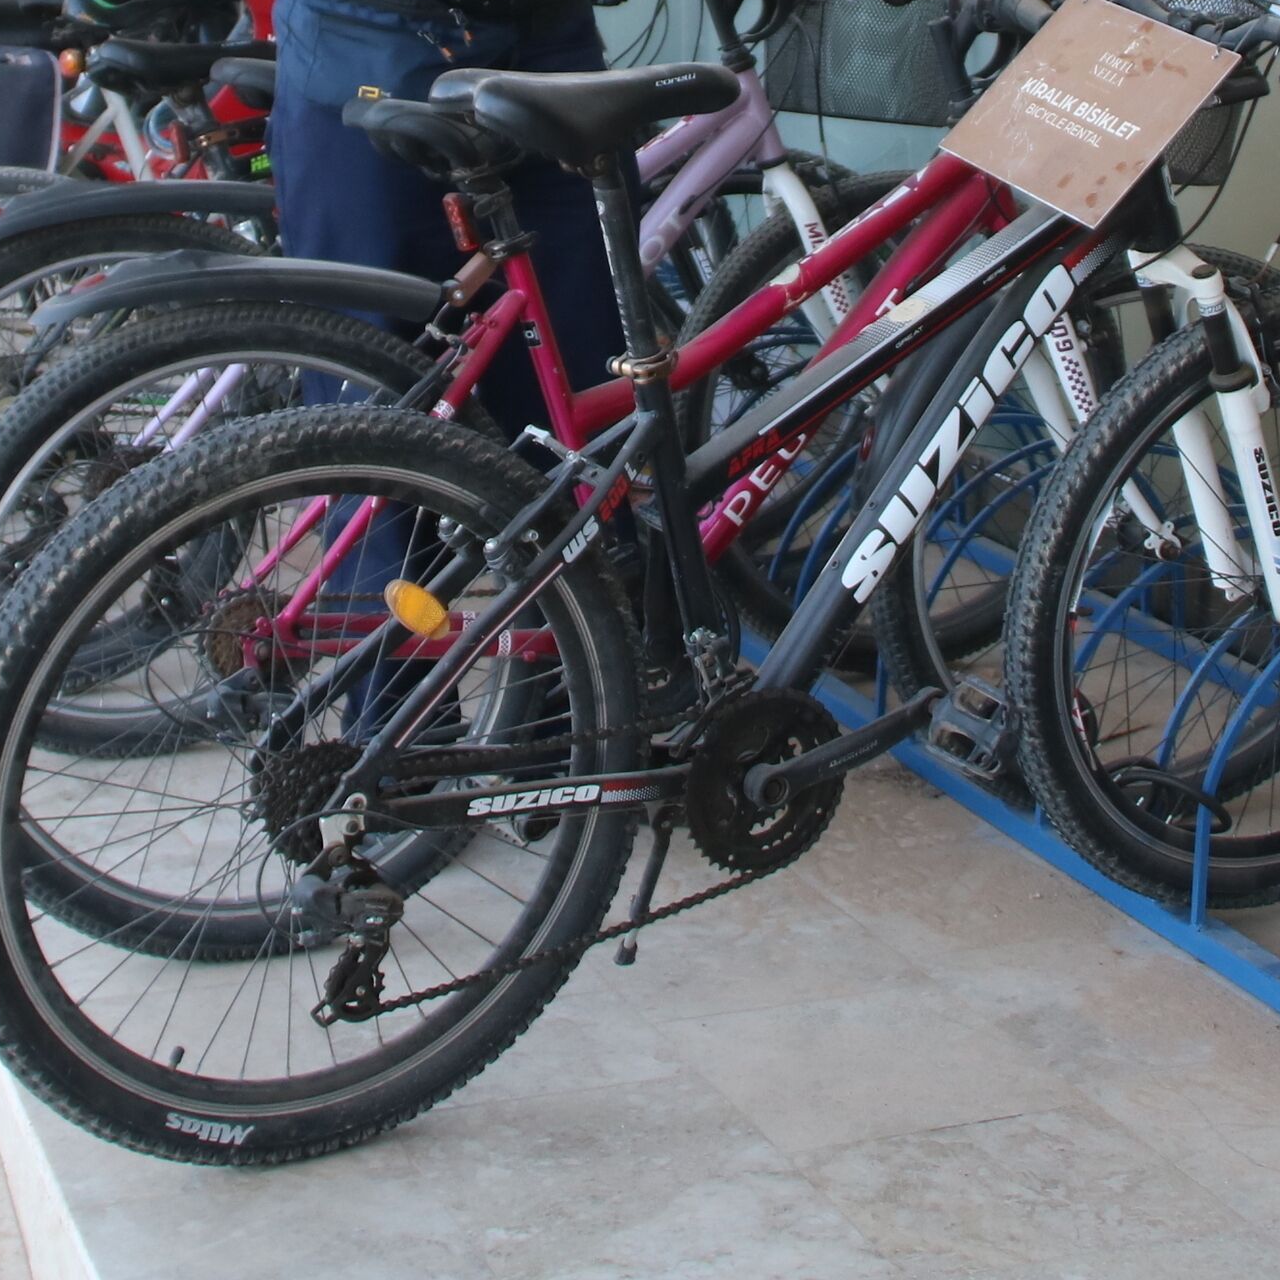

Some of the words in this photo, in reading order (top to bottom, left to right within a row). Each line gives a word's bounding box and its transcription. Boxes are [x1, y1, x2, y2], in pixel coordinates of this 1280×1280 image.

[1020, 76, 1079, 113] KİRALIK
[1073, 101, 1141, 141] BİSİKLET
[1025, 103, 1067, 130] BICYCLE
[1063, 122, 1104, 148] RENTAL
[165, 1111, 256, 1148] Mitas
